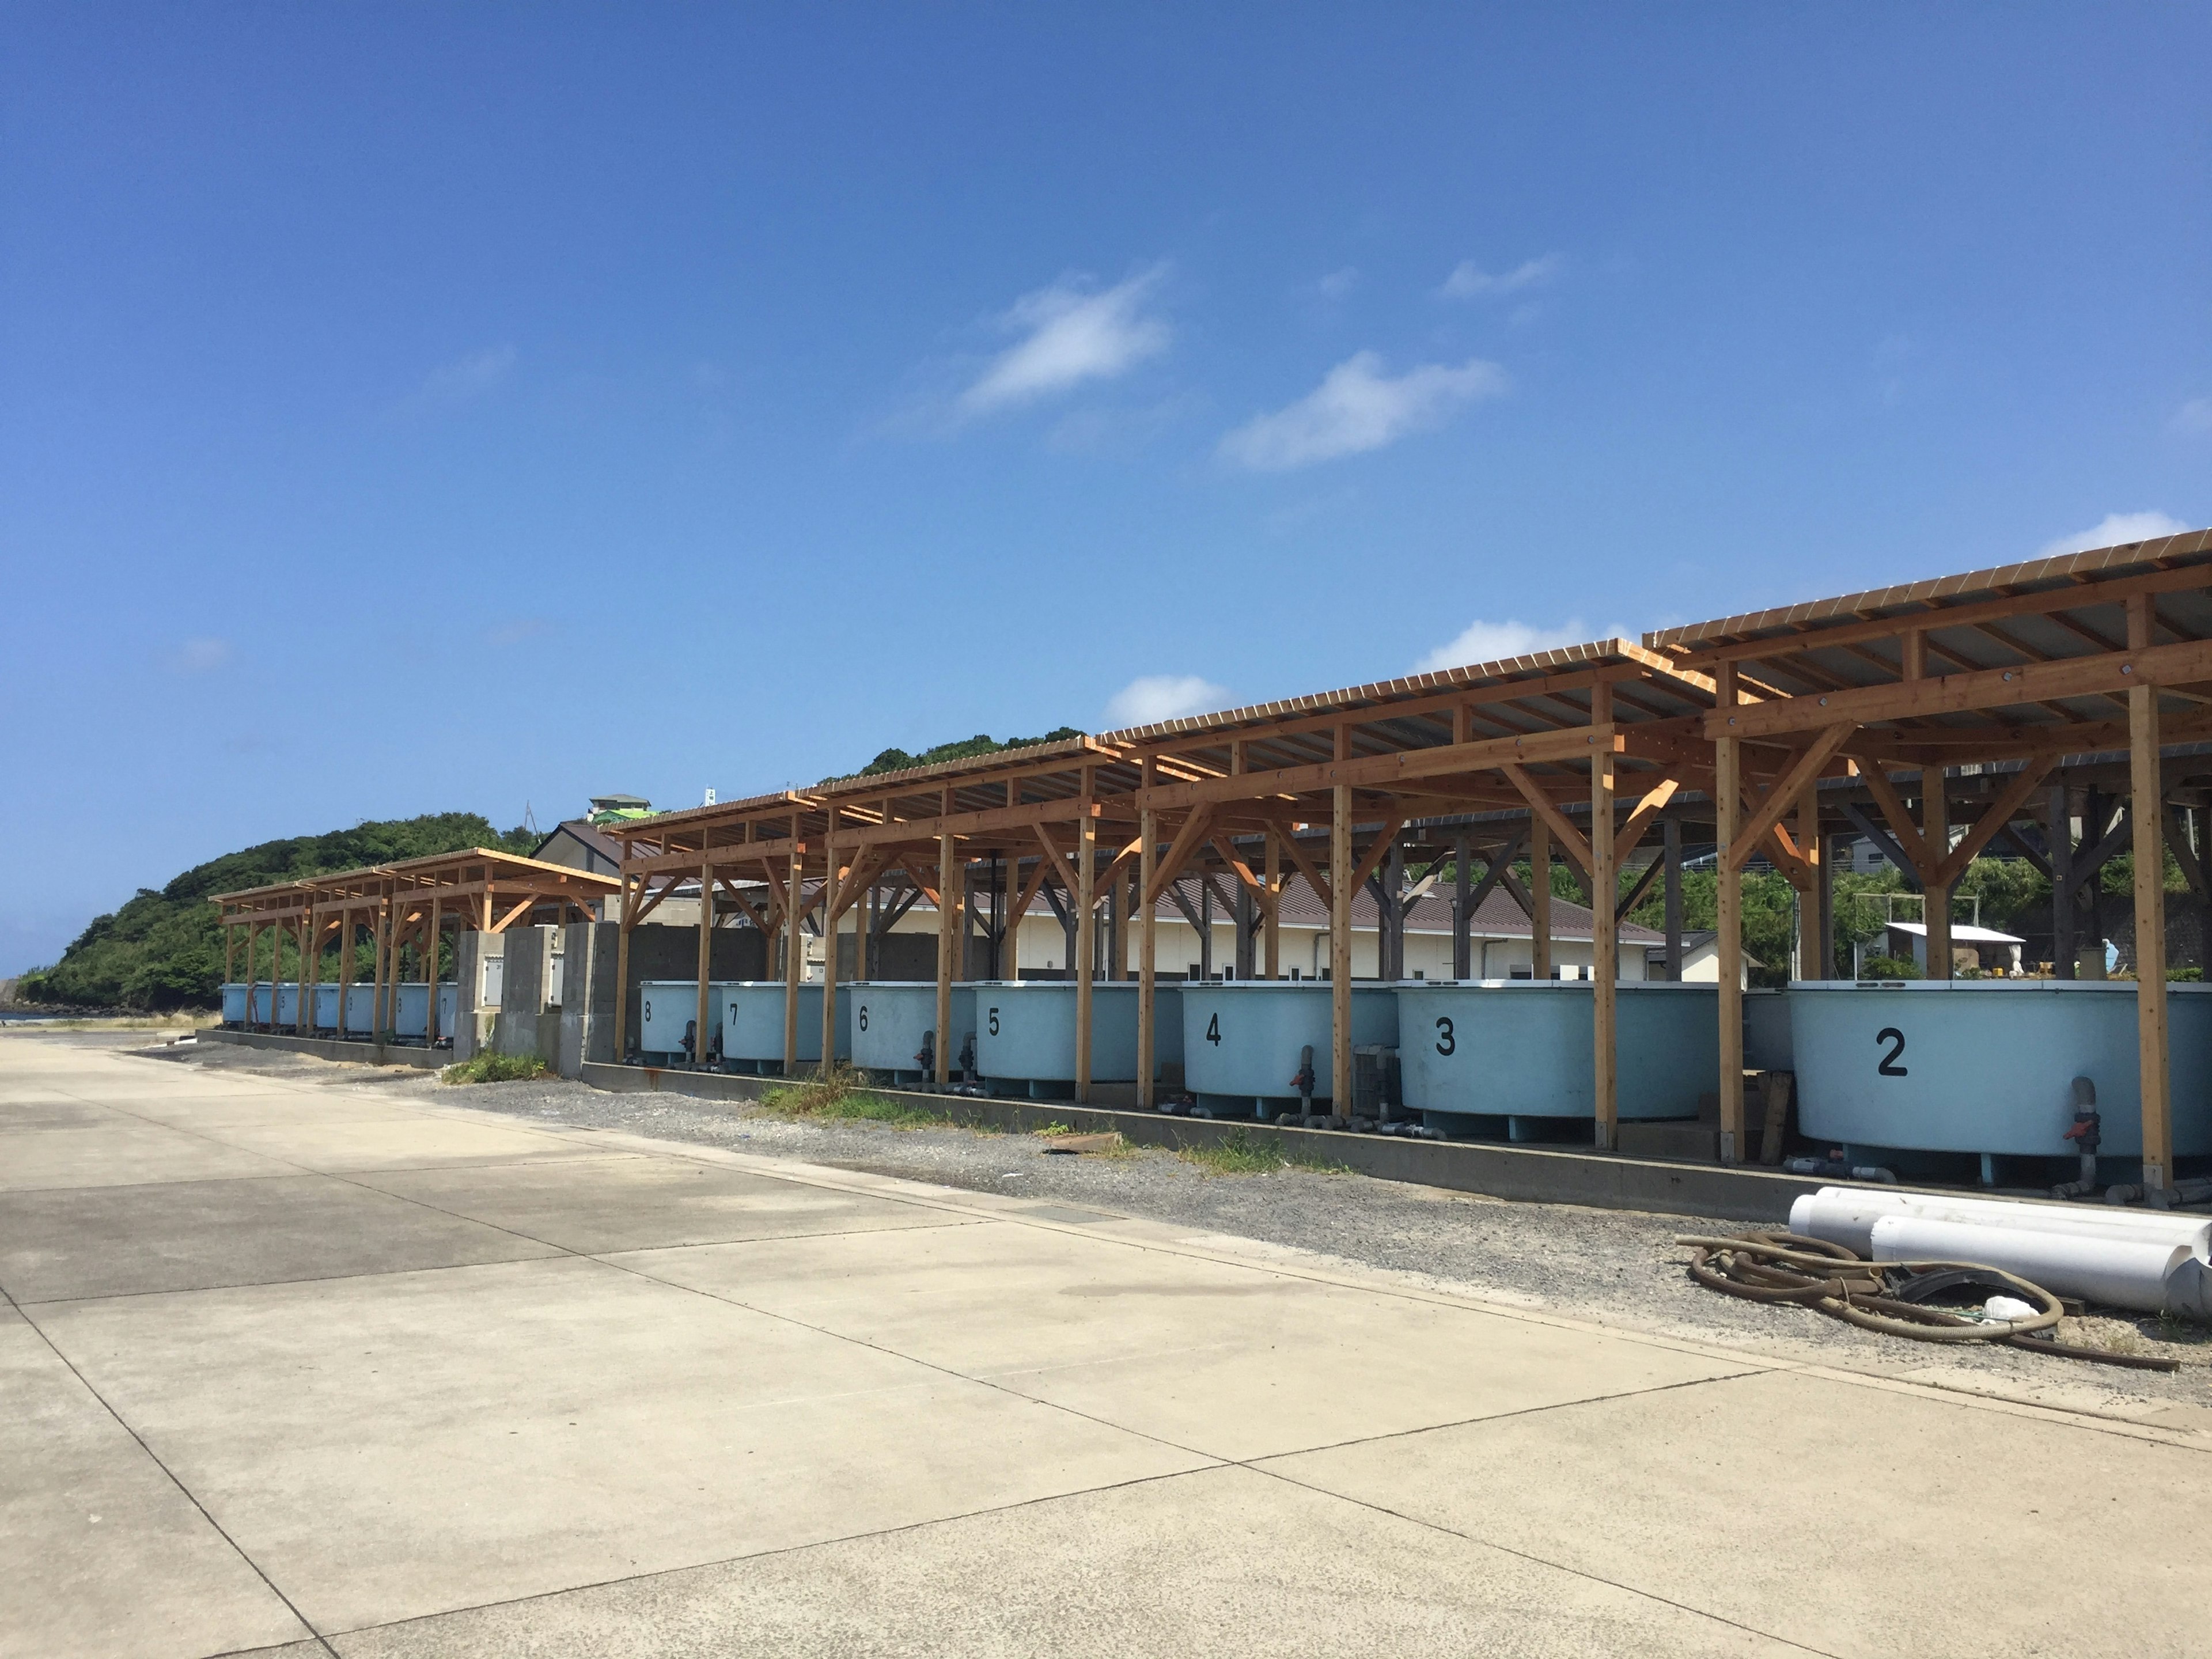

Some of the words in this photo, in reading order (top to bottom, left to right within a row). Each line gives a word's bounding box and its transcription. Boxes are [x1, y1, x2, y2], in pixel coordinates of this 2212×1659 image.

[645, 1001, 651, 1022] 8
[730, 1003, 738, 1026] 7
[859, 1005, 869, 1032] 6
[989, 1007, 999, 1036] 5
[1205, 1012, 1221, 1047] 4
[1435, 1017, 1456, 1056] 3
[1876, 1027, 1908, 1077] 2
